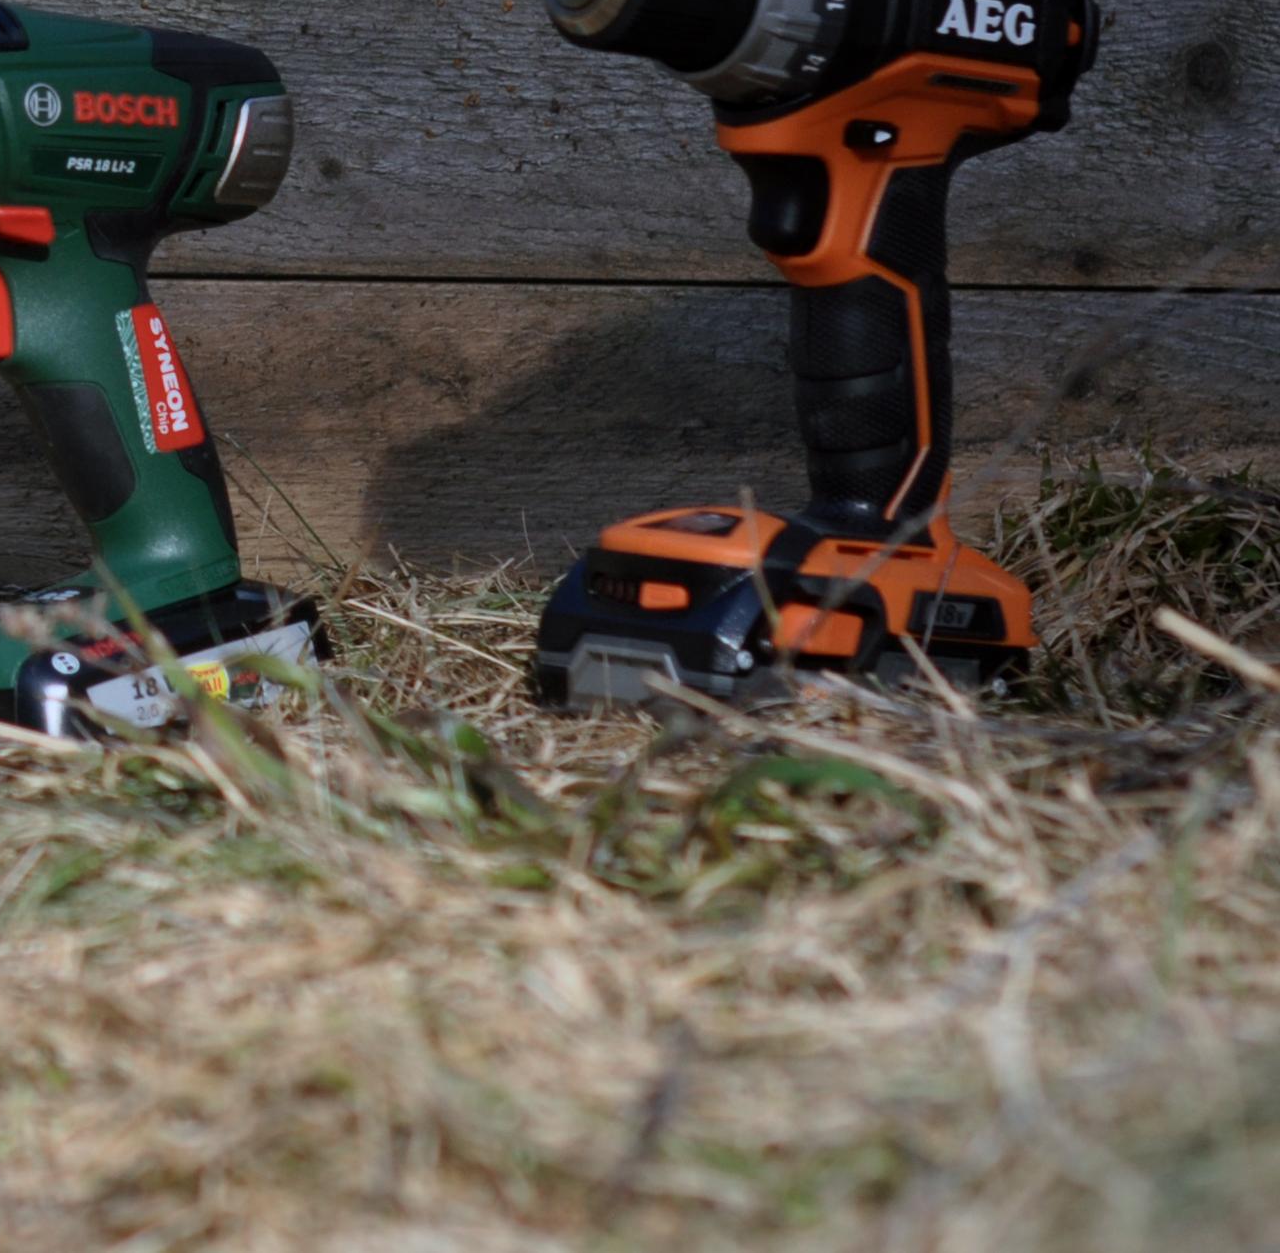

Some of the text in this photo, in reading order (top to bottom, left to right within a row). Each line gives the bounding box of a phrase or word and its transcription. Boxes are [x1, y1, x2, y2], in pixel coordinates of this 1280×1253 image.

[801, 54, 827, 72] 14
[74, 91, 179, 127] BOSCH
[66, 157, 93, 171] PSR
[94, 159, 110, 172] 18
[150, 317, 189, 432] SYNEON
[156, 401, 169, 435] Chip
[133, 677, 160, 700] 18
